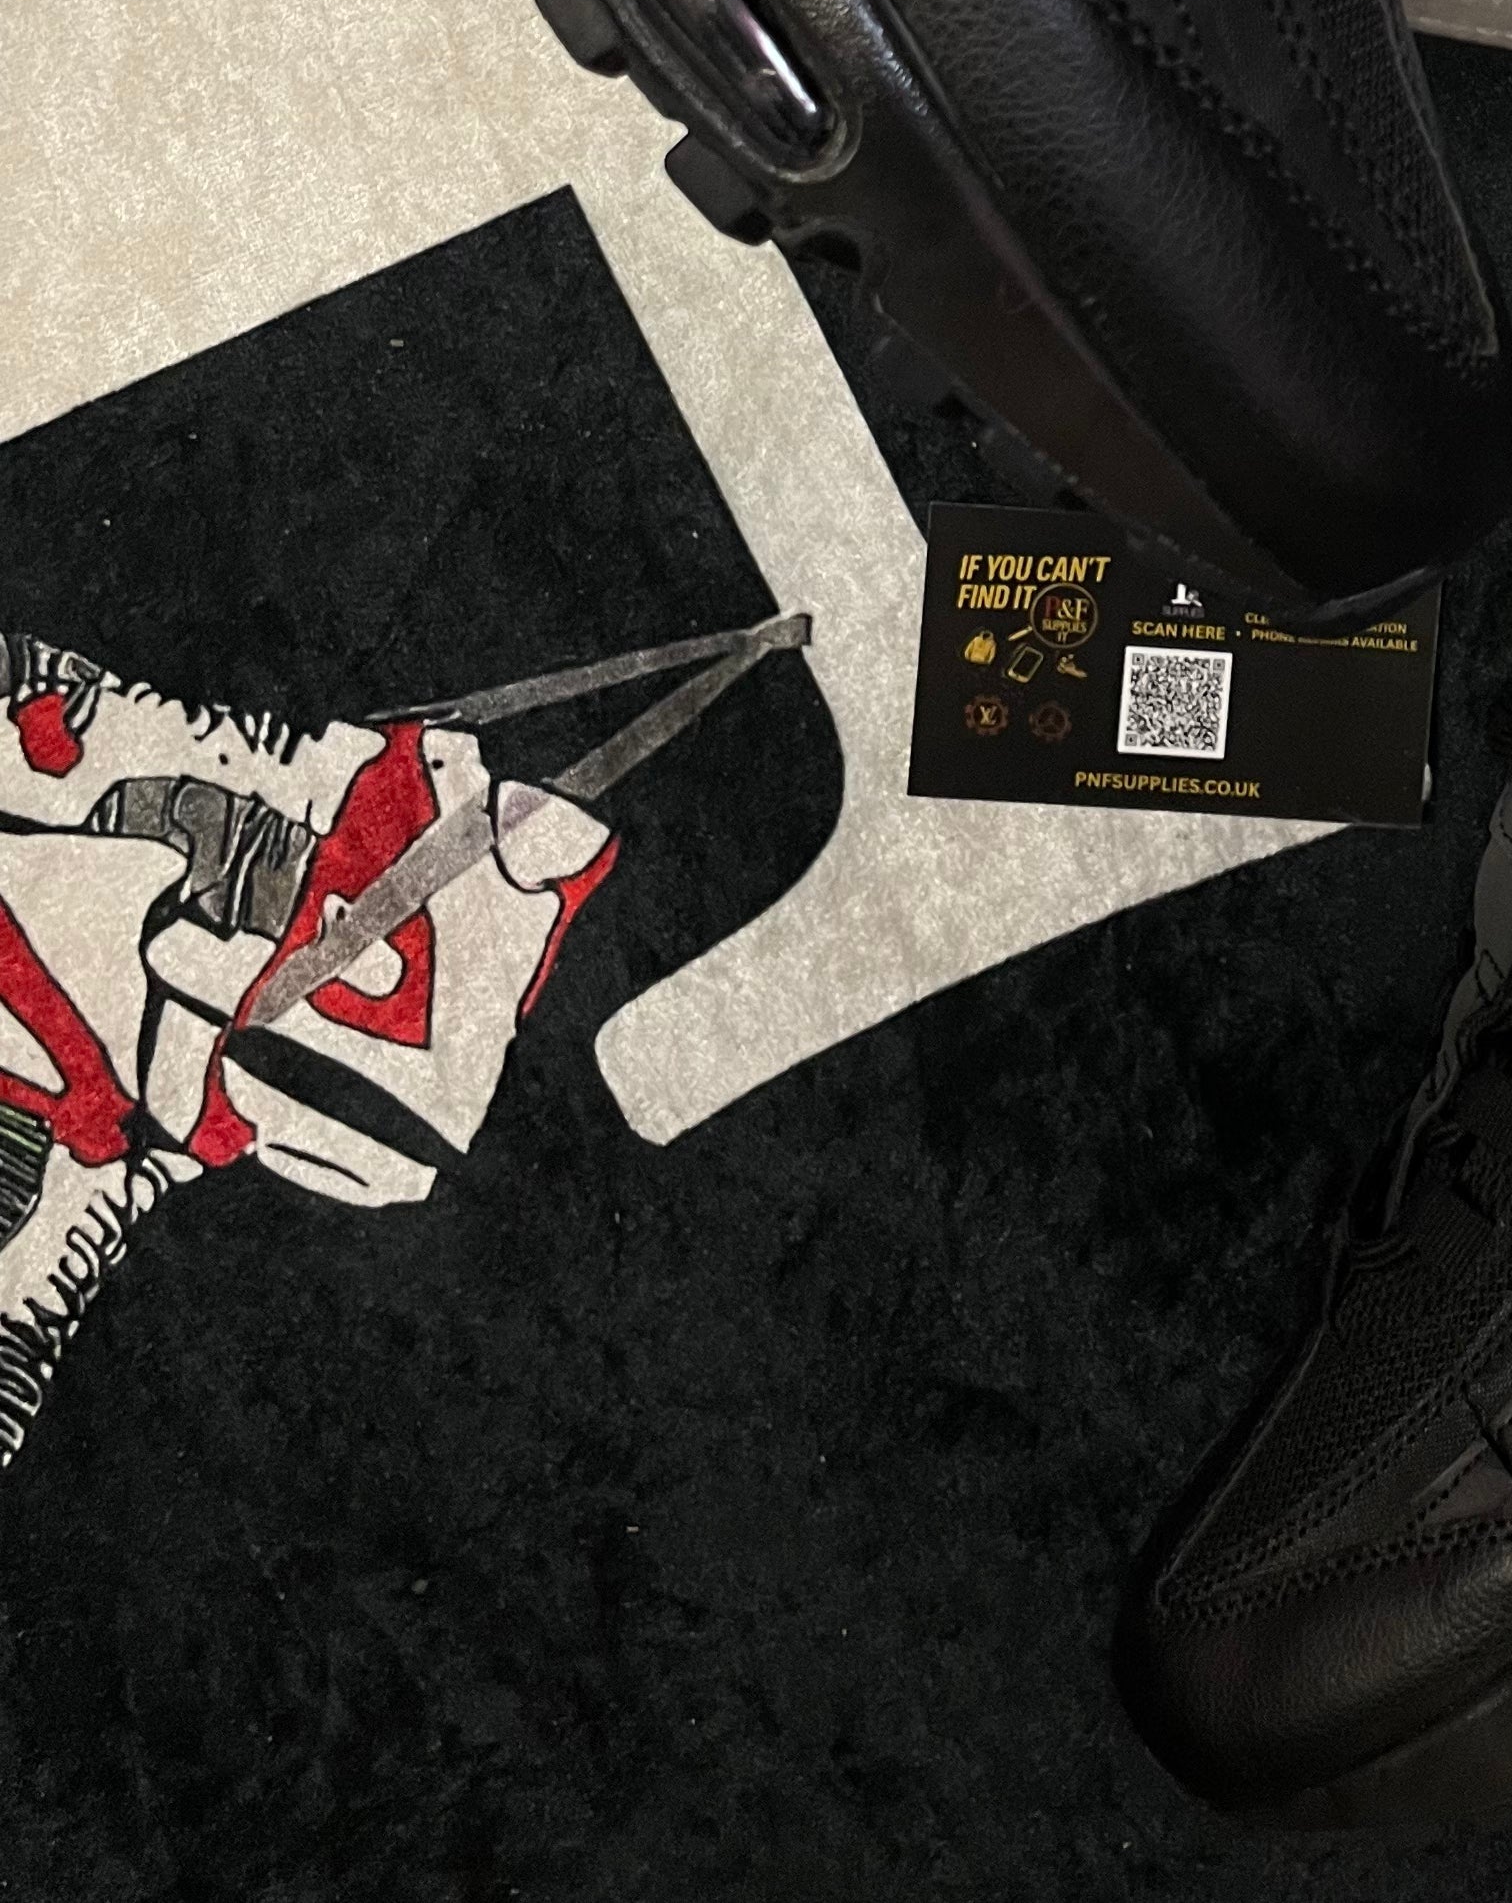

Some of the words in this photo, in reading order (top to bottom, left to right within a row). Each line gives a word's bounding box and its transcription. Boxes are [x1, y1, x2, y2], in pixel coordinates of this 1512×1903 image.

[959, 554, 983, 581] IF
[987, 554, 1034, 582] YOU
[1036, 556, 1112, 583] CAN'T
[957, 584, 1010, 609] FIND
[1013, 585, 1037, 610] IT
[1044, 595, 1090, 621] P&F
[1042, 619, 1087, 634] SUPPLIES
[1132, 620, 1178, 638] SCAN
[1181, 624, 1226, 641] HERE
[1351, 636, 1418, 652] AVAILABLE
[1075, 771, 1261, 799] PNFSUPPLIES.CO.UK
